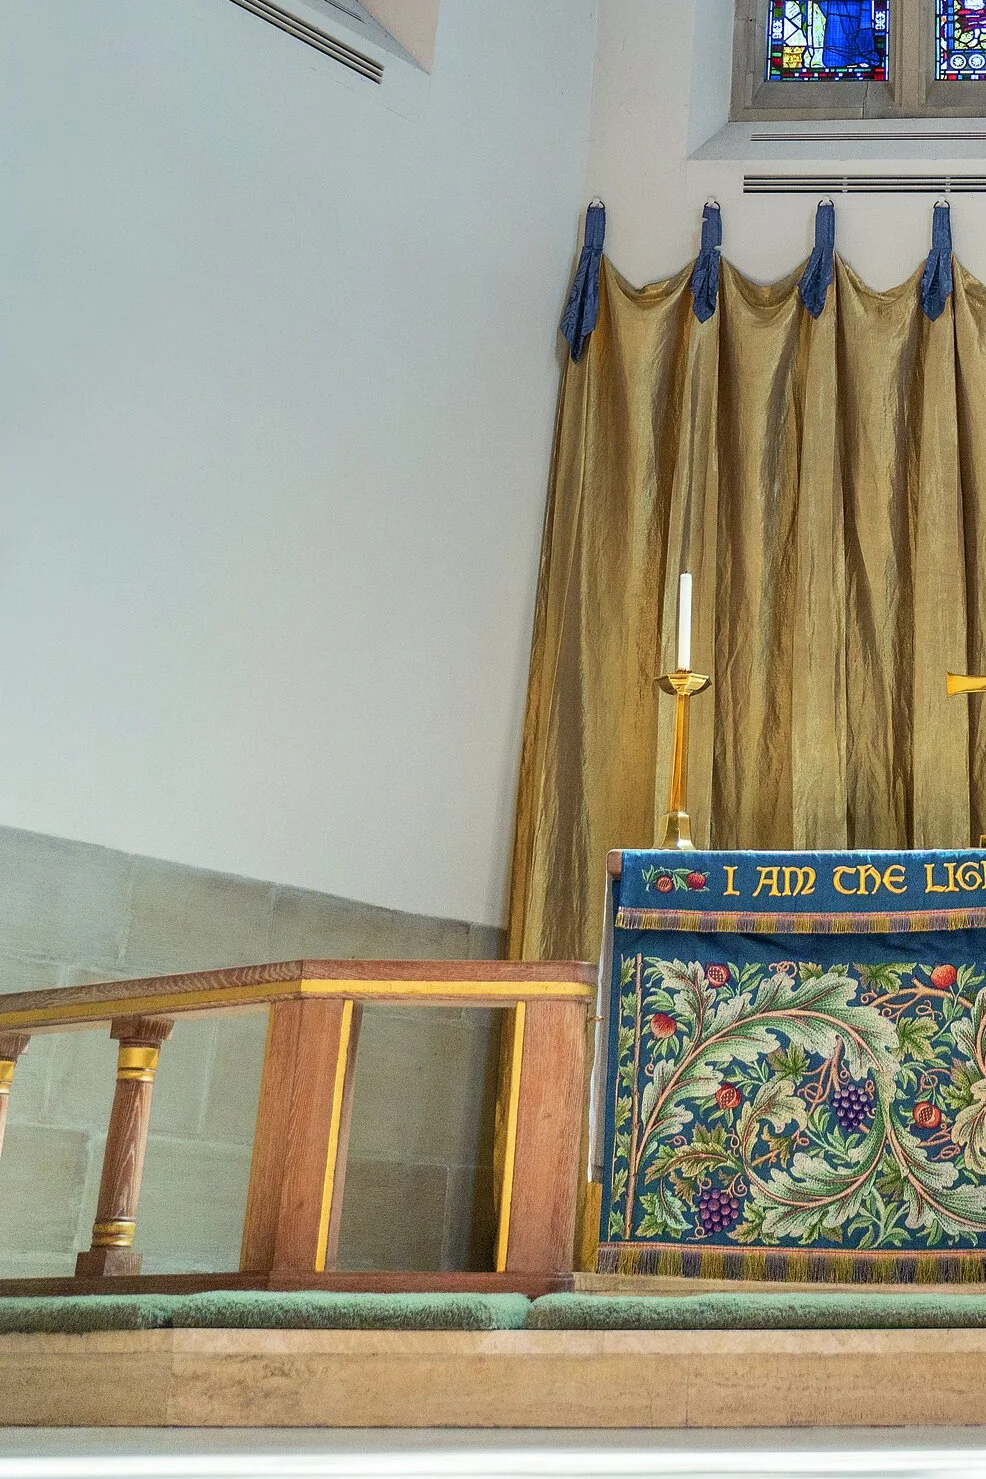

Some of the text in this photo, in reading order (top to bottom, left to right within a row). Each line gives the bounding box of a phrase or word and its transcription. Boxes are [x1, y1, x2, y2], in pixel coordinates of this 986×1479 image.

[723, 865, 740, 896] I
[752, 866, 816, 897] AM
[832, 864, 907, 896] THE
